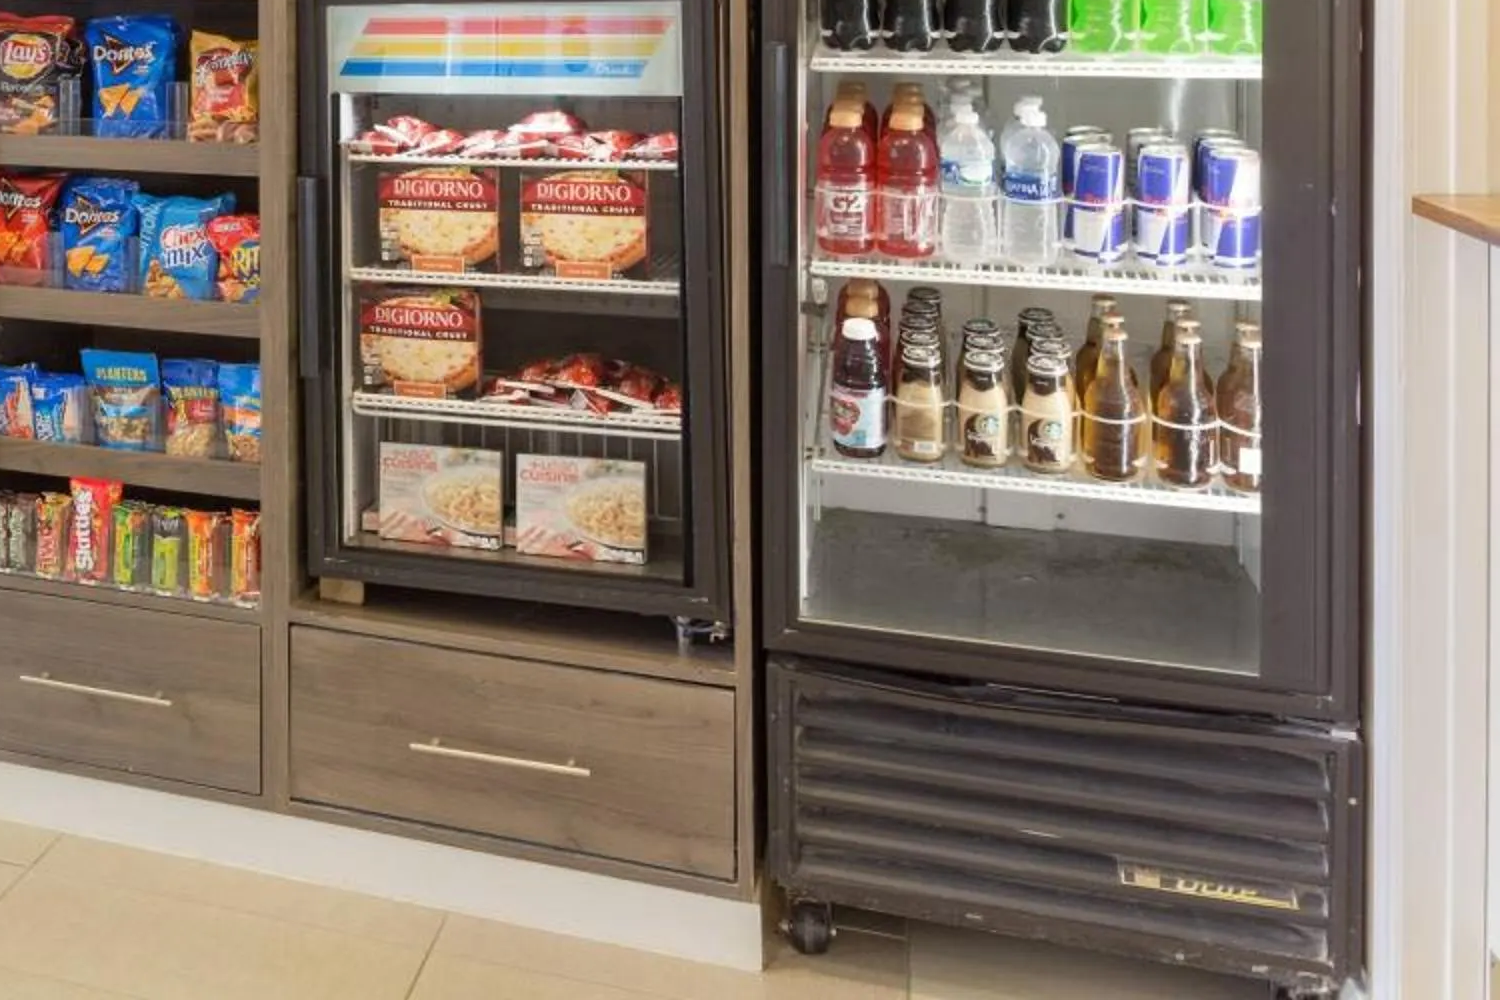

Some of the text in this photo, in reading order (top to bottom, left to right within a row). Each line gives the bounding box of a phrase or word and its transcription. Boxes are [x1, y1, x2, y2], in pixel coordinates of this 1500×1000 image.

[93, 41, 157, 63] Doritos
[387, 199, 488, 209] TRADITIONAL CRUST
[531, 203, 636, 214] TRADITIONAL CRUST
[65, 207, 120, 224] Doritos
[369, 325, 433, 338] TRADITIONAL
[95, 365, 147, 383] PLANTERS
